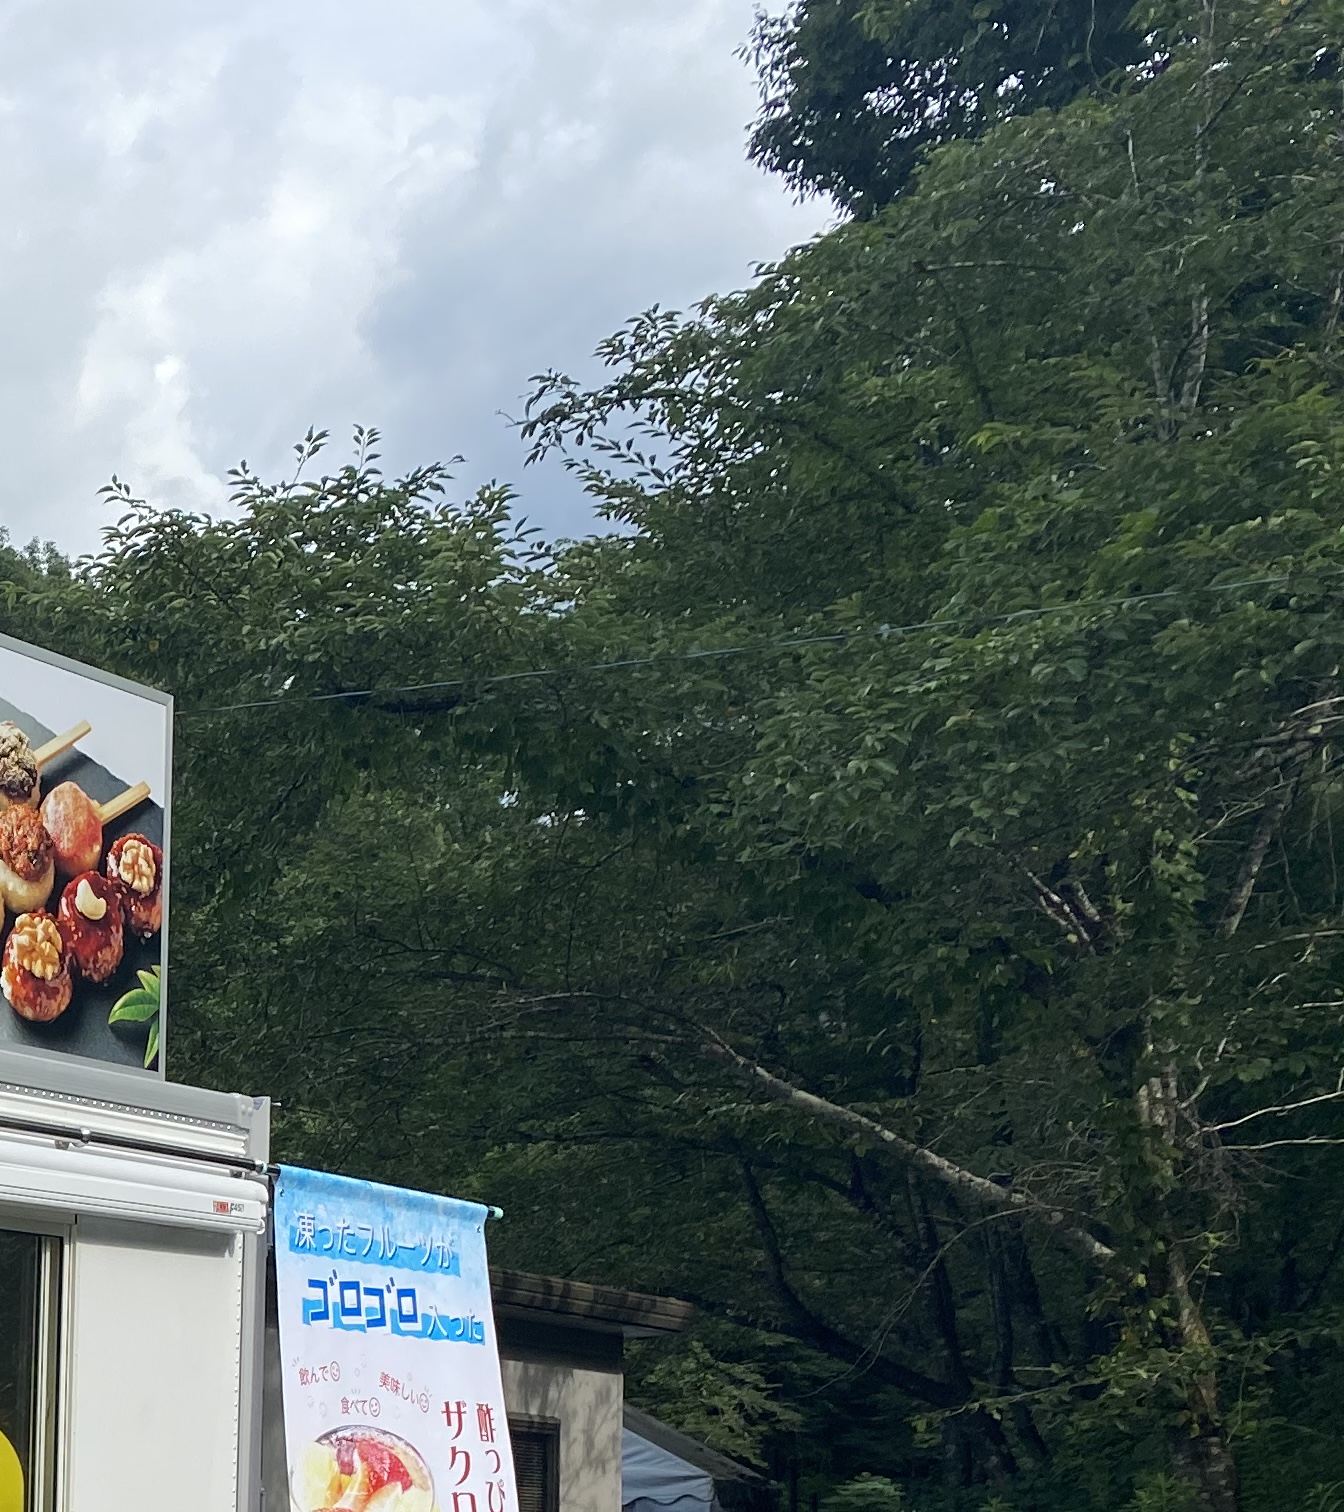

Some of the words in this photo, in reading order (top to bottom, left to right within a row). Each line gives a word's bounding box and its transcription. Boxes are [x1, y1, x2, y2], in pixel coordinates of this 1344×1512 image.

[294, 1211, 455, 1268] 凍ったフルーツが
[299, 1365, 329, 1386] 飲んで
[340, 1396, 368, 1416] 食べて
